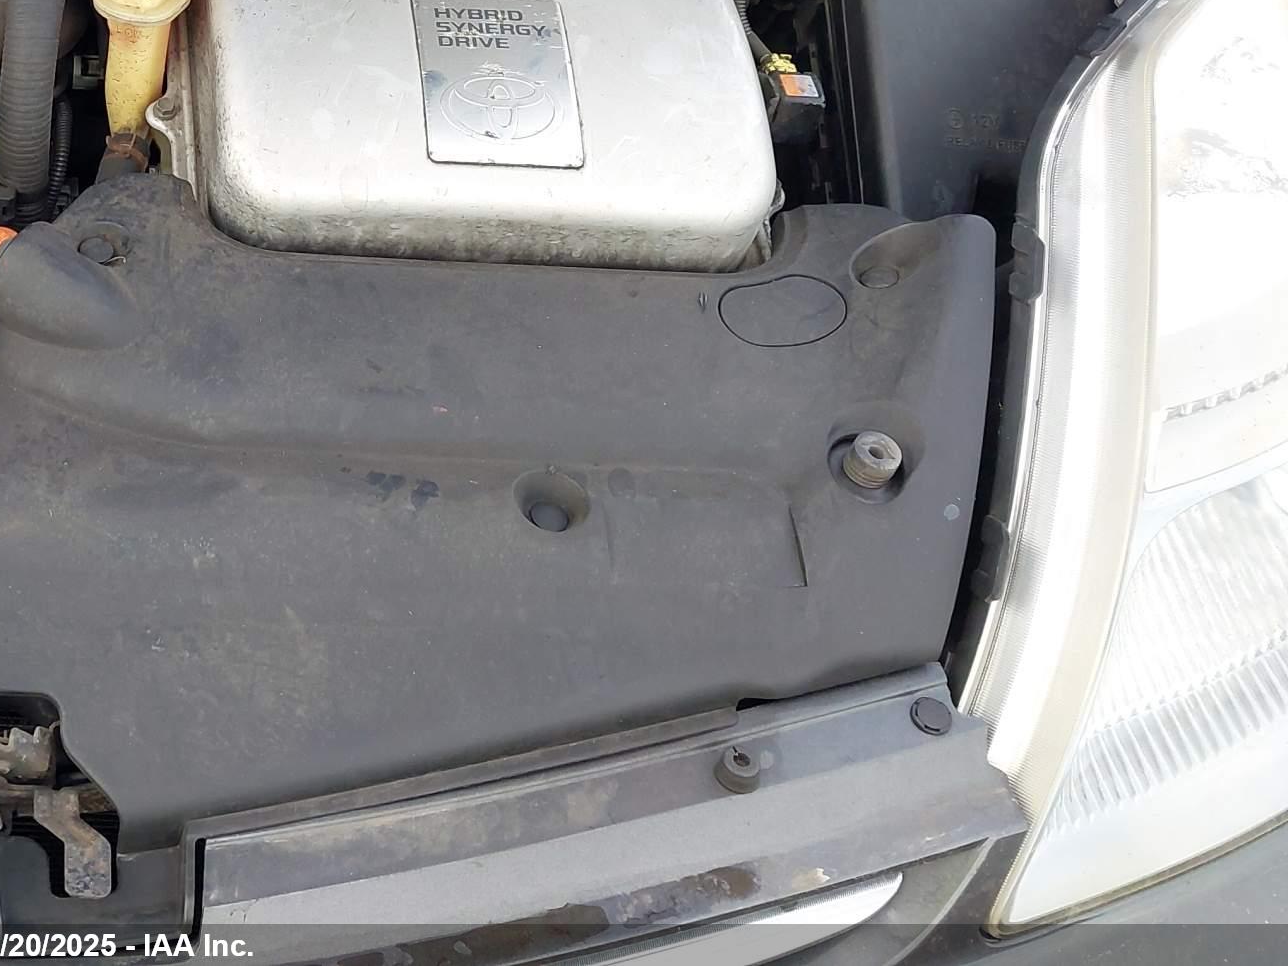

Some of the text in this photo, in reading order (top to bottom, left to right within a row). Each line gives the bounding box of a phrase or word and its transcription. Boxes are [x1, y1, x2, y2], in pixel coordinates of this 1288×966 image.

[434, 8, 523, 22] HYBRID
[436, 21, 546, 37] SYNERGY
[438, 35, 510, 49] DRIVE
